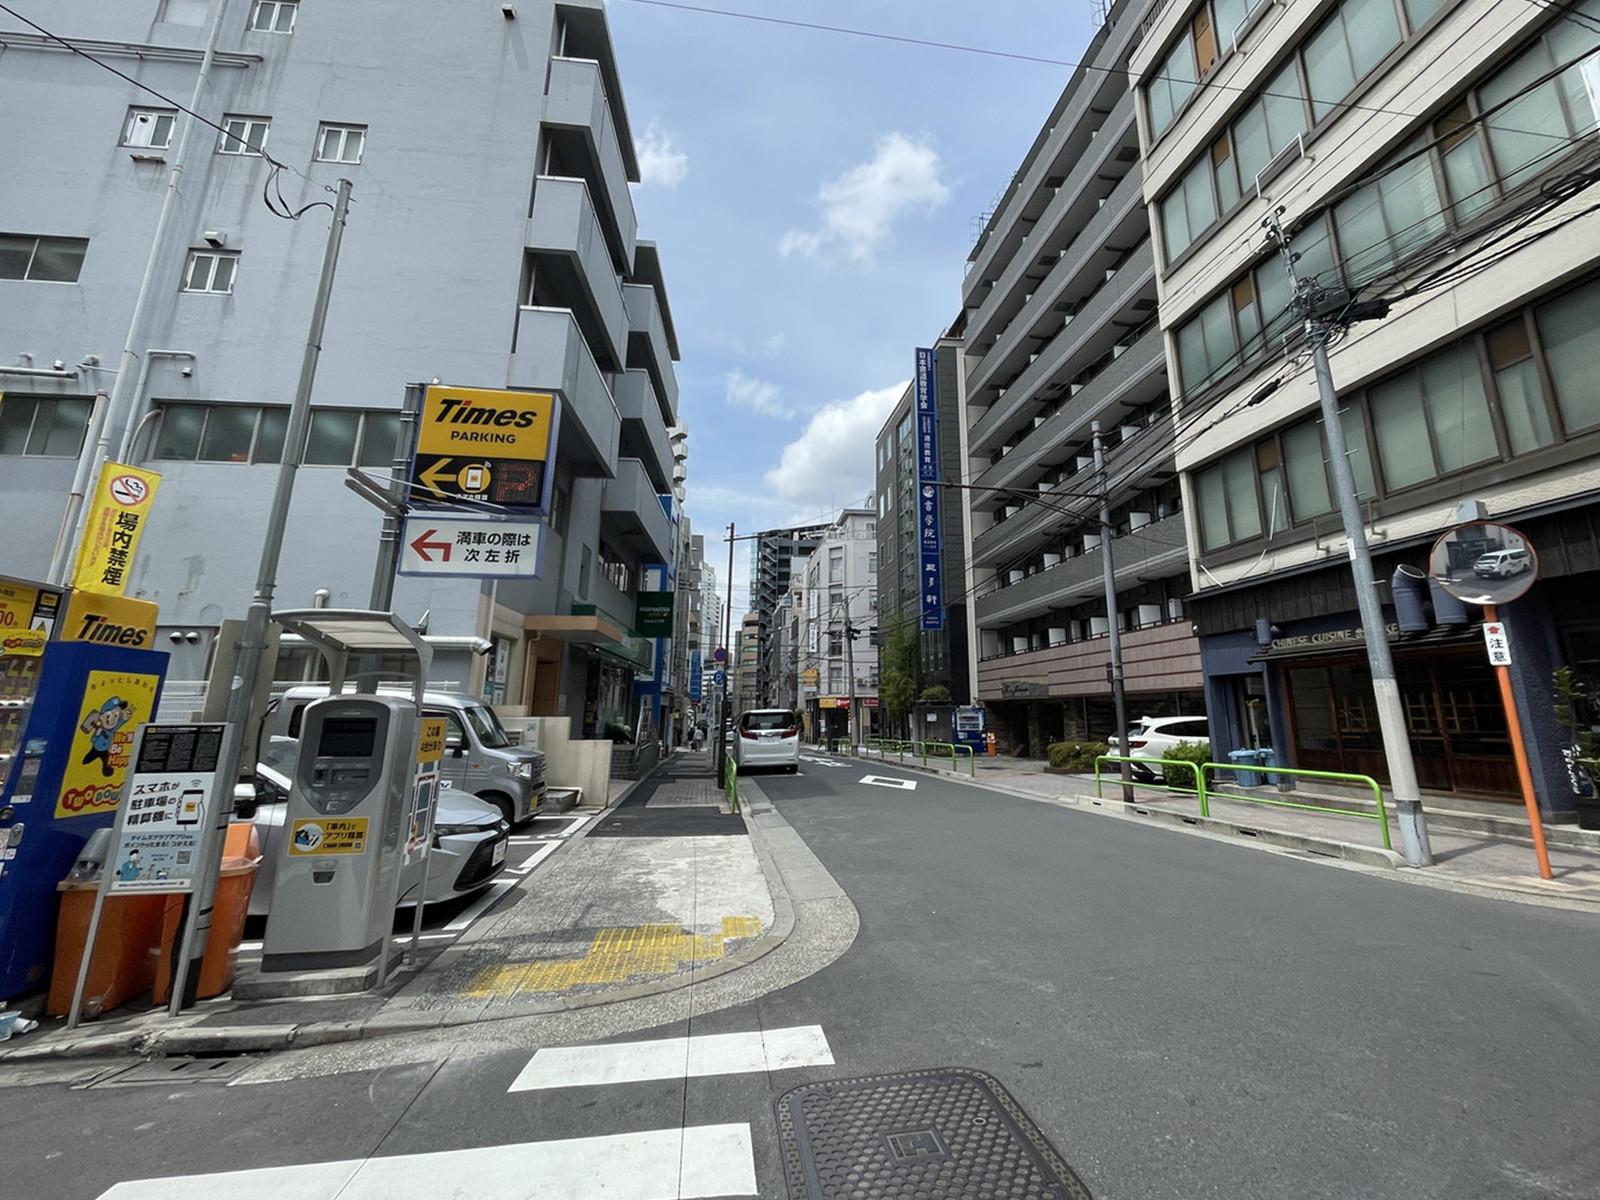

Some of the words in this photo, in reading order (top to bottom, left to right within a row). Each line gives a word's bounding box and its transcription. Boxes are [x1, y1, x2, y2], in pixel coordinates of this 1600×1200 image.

[435, 398, 538, 429] Times
[450, 430, 517, 445] PARKING
[456, 530, 532, 547] 満車の際は
[101, 511, 140, 586] 場内禁煙
[463, 548, 521, 564] 次左折
[77, 613, 148, 646] Times
[1271, 635, 1309, 650] CHINESE
[1311, 629, 1352, 645] CUISINE
[1488, 637, 1507, 662] 注意
[133, 781, 180, 796] スマホが
[130, 795, 177, 811] 駐車場の
[127, 811, 174, 826] 精算機に
